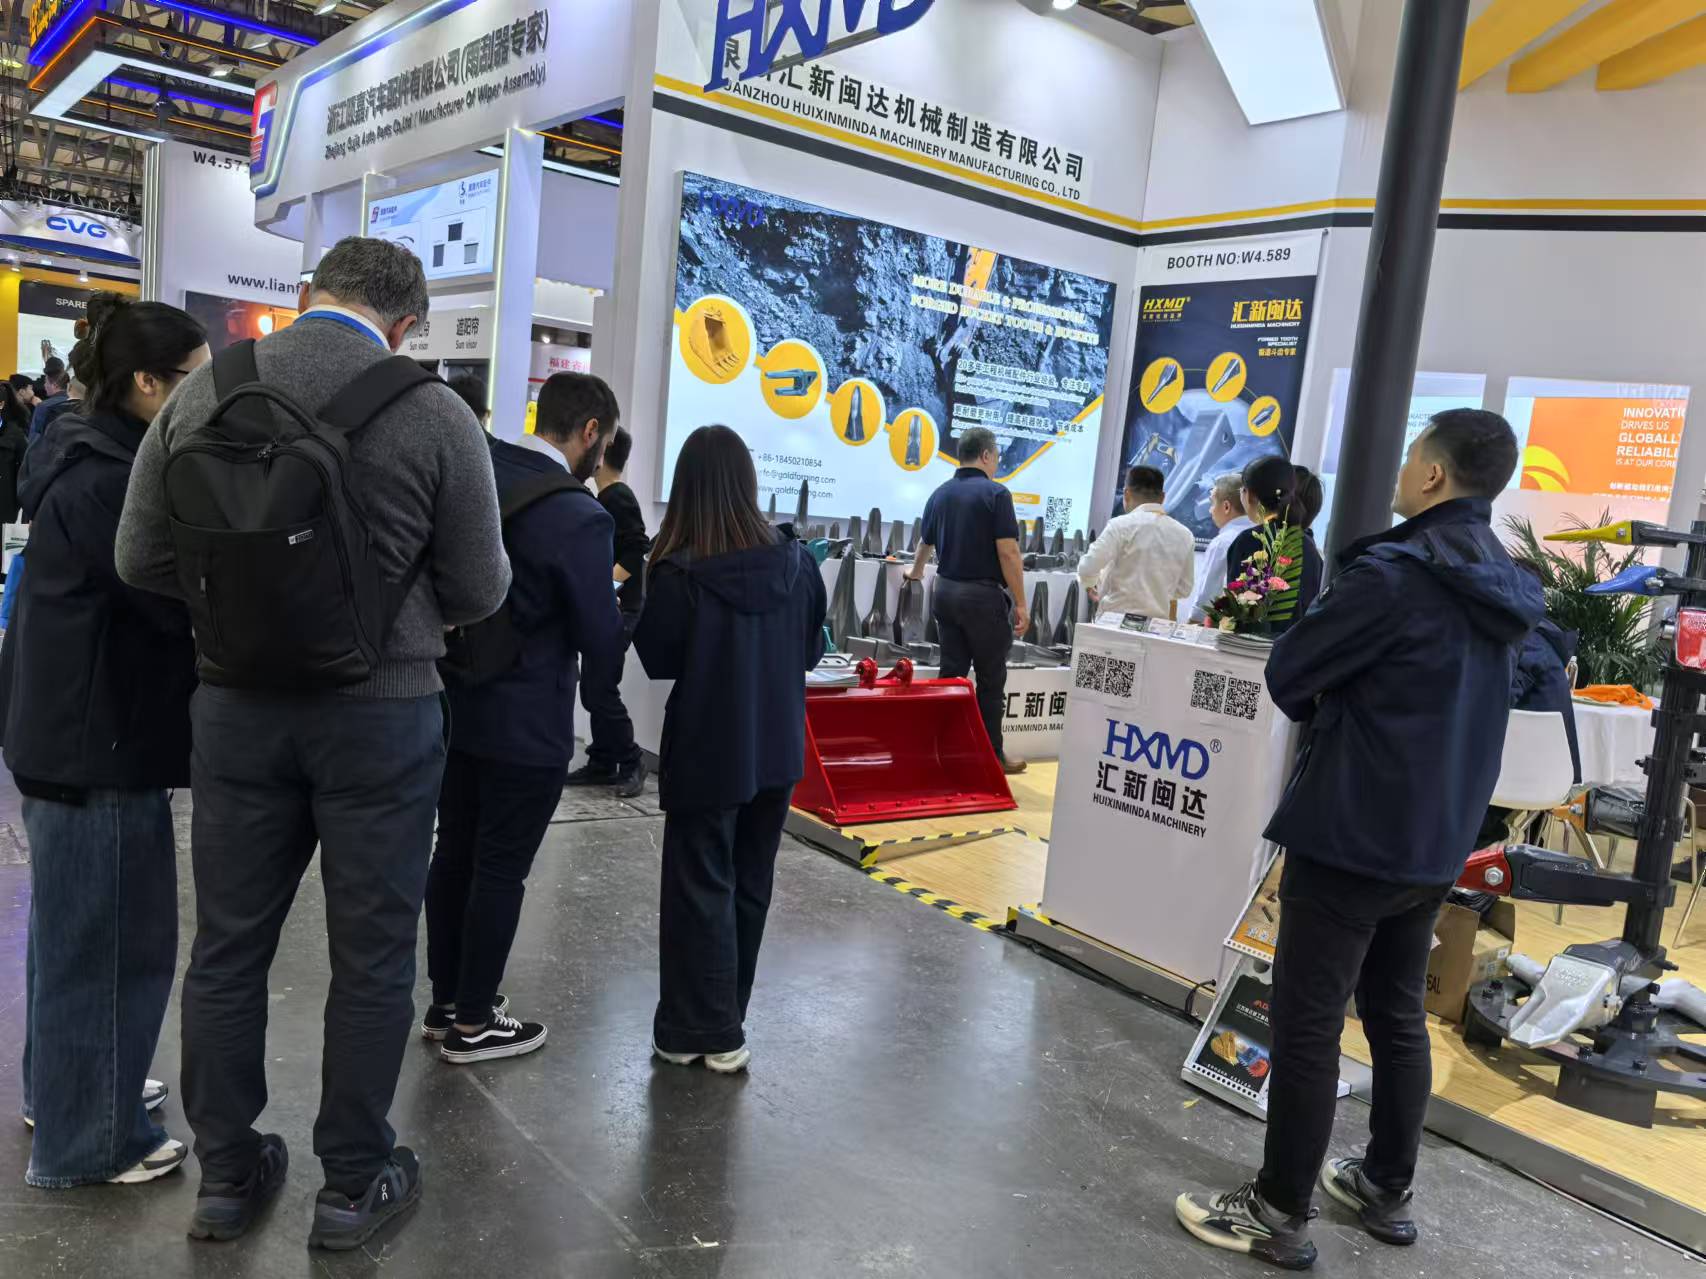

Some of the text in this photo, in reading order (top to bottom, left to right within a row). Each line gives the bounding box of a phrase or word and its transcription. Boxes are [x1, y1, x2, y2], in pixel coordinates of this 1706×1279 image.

[478, 83, 502, 104] Wiper
[792, 100, 878, 137] HUIXINMINDA
[879, 128, 947, 158] MACHINERY
[948, 151, 1040, 188] MANUFACTURING
[1062, 183, 1081, 200] LTD
[46, 216, 107, 239] CVG
[1167, 253, 1213, 270] BOOTH
[55, 298, 87, 309] SPARE
[1232, 298, 1304, 323] 汇新闽达
[1621, 420, 1670, 431] DRIVES US
[1102, 718, 1210, 780] HXMD
[1096, 760, 1208, 820] 汇新闽达
[1093, 792, 1207, 839] HUIXINMINDA MACHINERY
